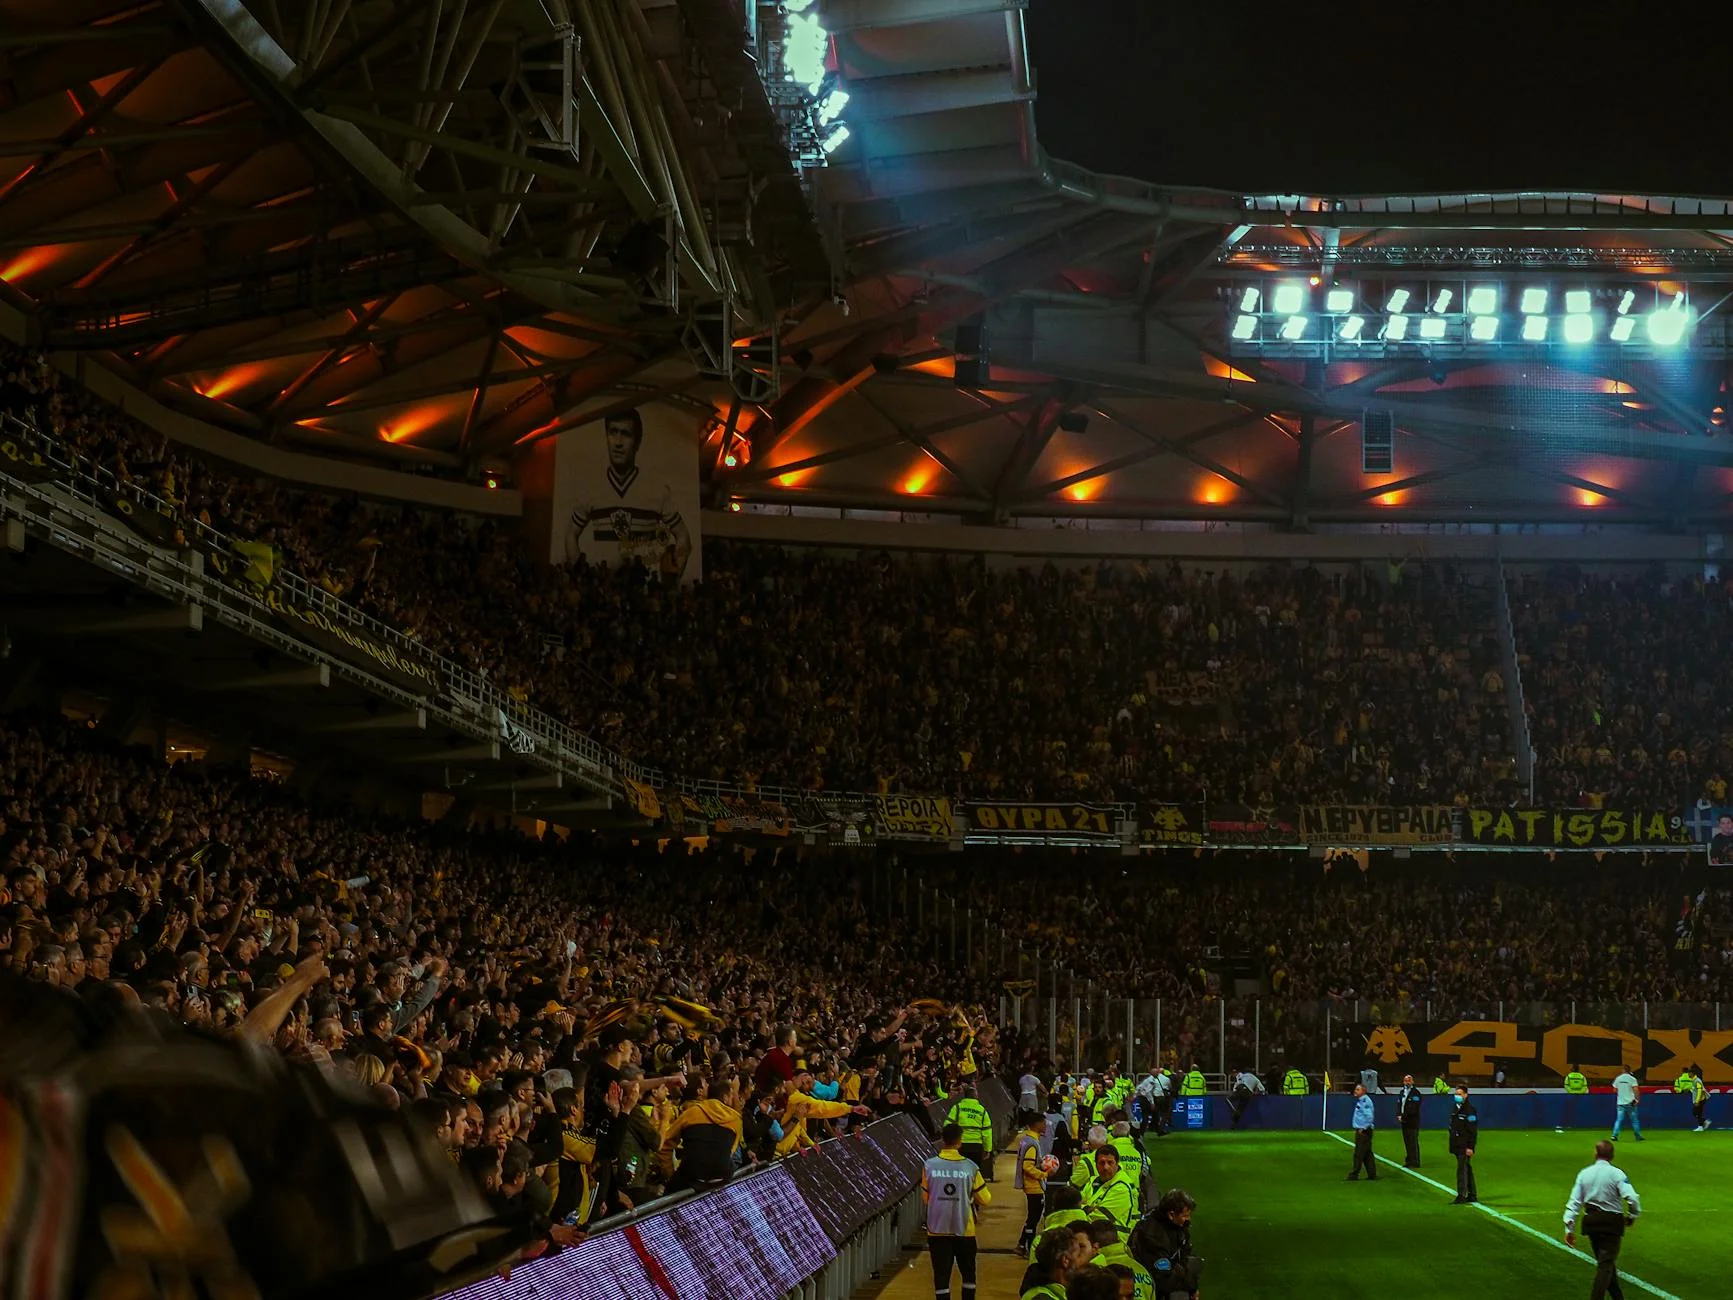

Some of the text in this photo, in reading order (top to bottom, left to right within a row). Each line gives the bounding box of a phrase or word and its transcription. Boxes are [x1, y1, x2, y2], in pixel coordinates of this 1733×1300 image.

[976, 807, 1109, 833] ΘΥΡΑ 21
[1468, 808, 1671, 846] PATISSIA
[931, 1169, 969, 1179] BALL BOY
